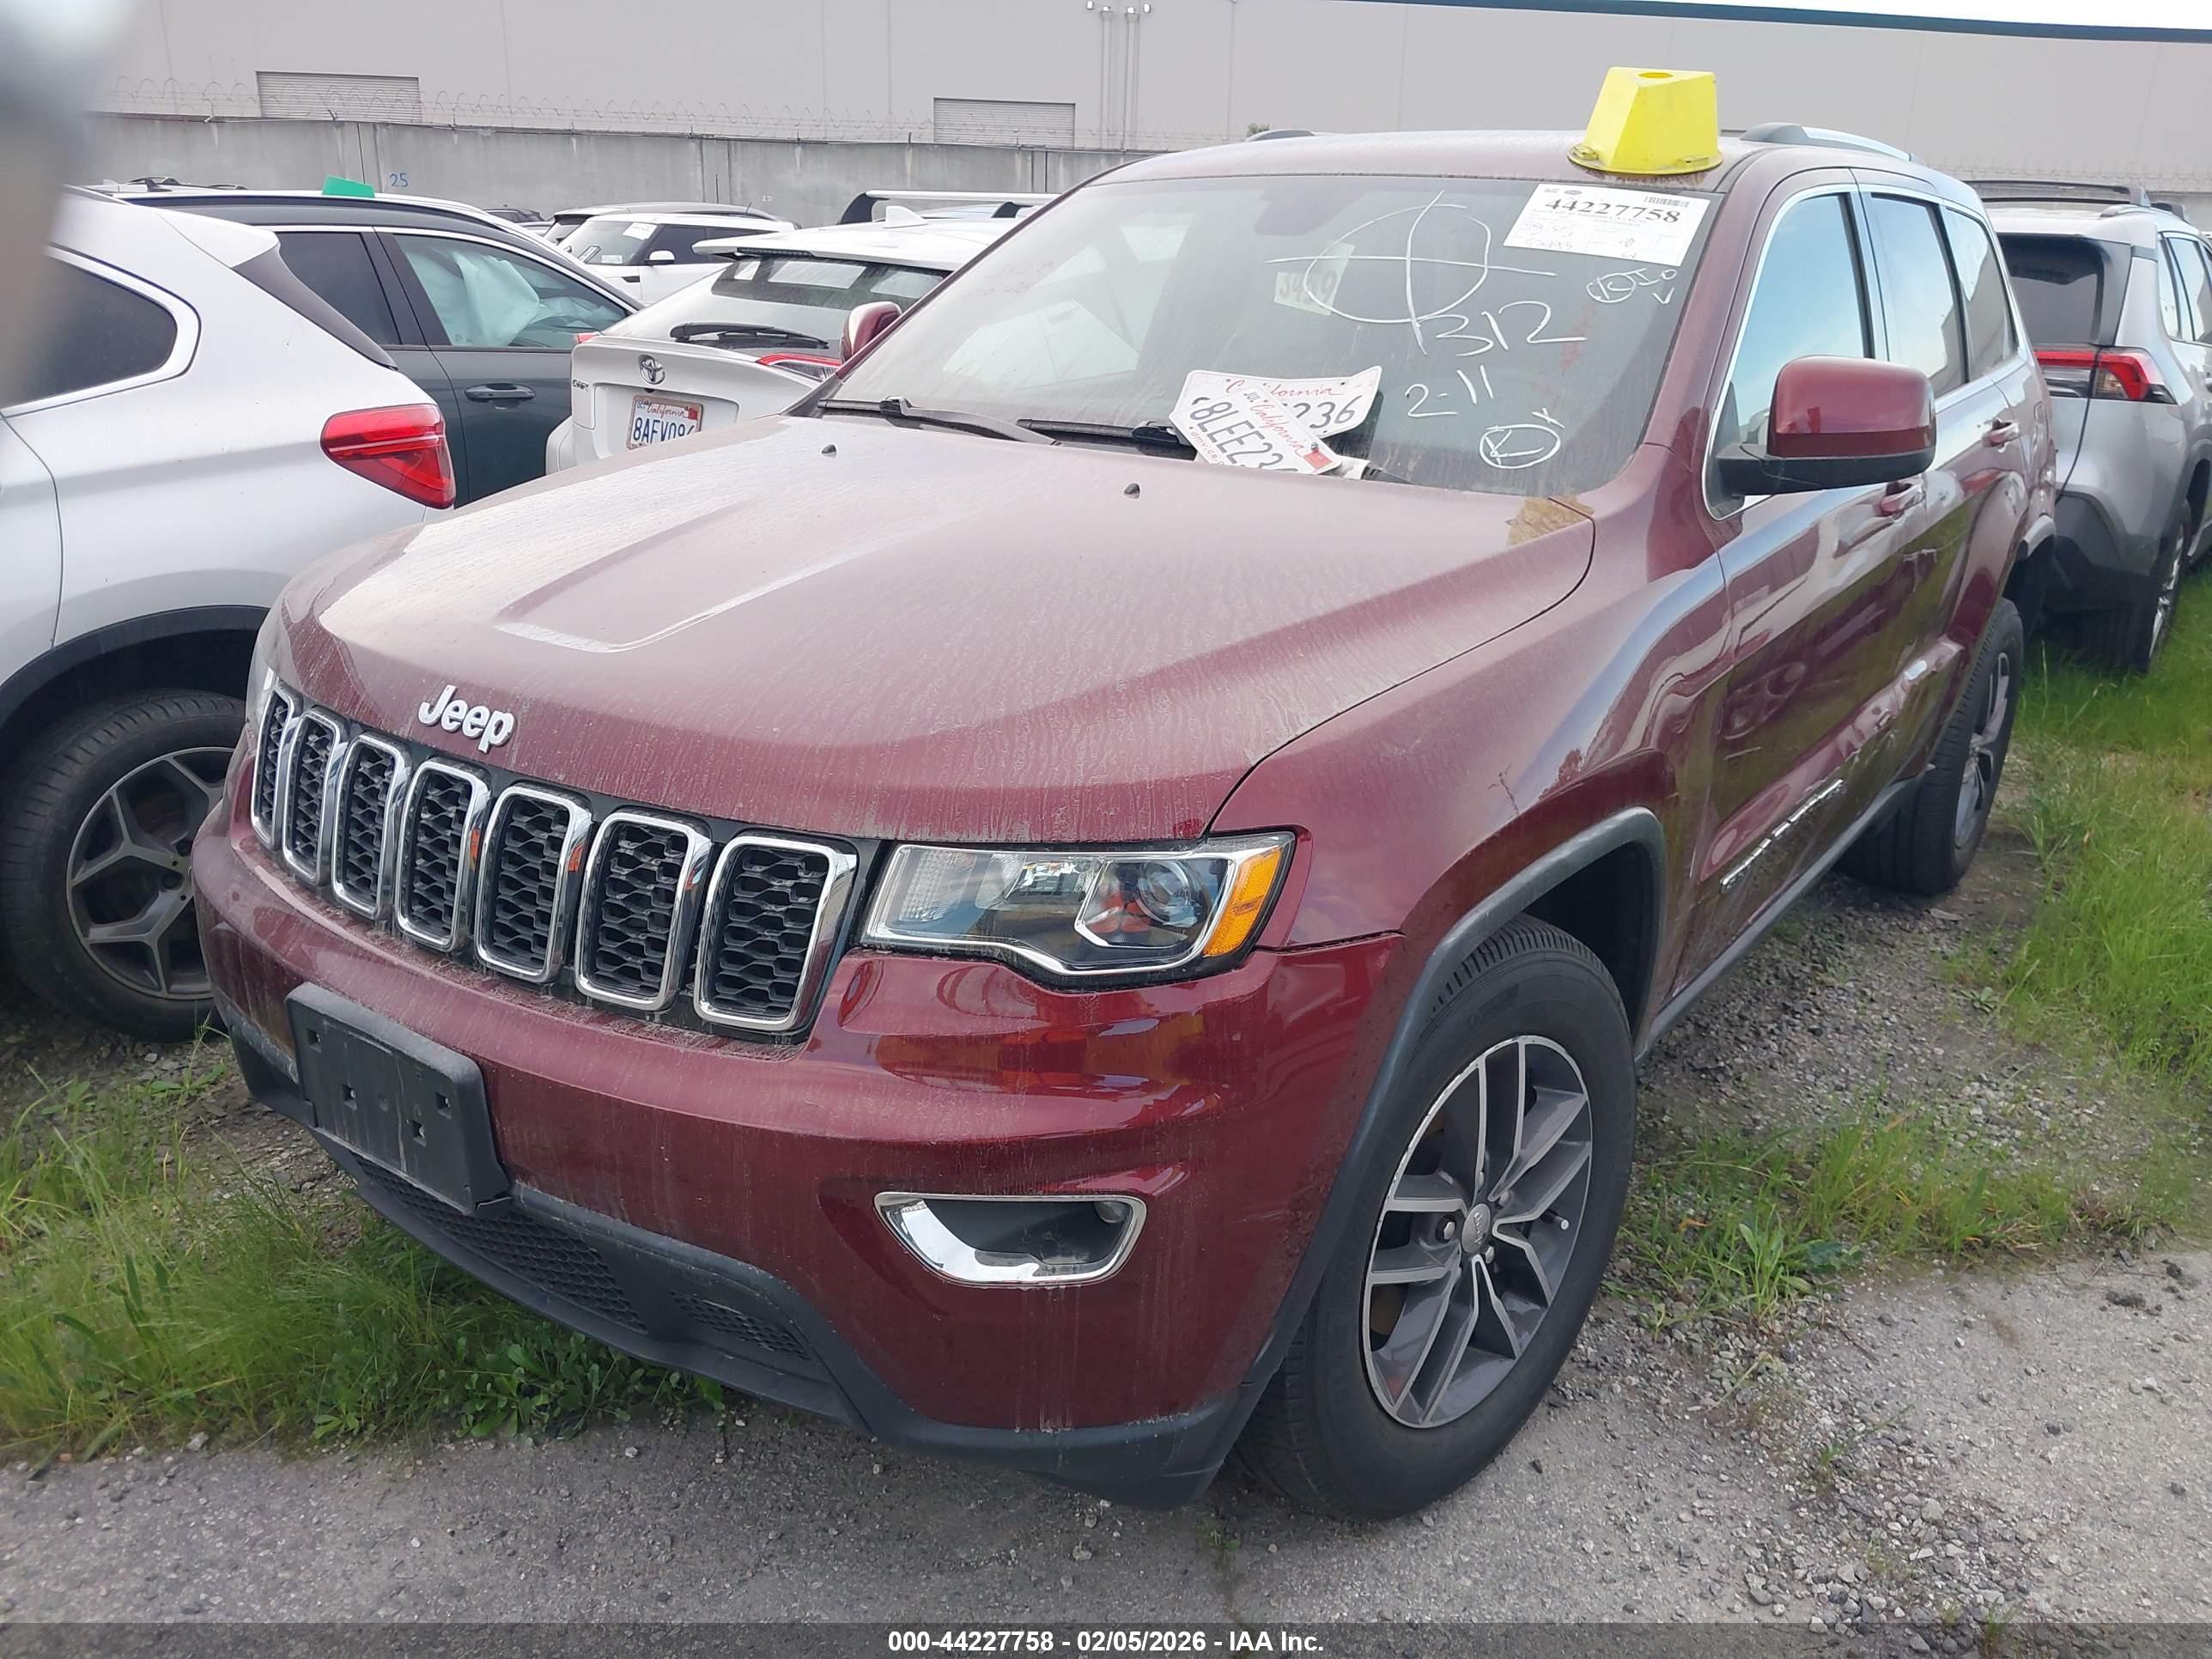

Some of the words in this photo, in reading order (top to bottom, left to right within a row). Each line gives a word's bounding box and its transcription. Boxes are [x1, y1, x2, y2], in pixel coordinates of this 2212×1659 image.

[389, 173, 409, 187] 25
[1544, 198, 1681, 223] 44227758
[647, 402, 690, 420] California
[1189, 401, 1299, 471] 8LEE23
[1250, 404, 1305, 459] California
[418, 684, 516, 754] Jeep
